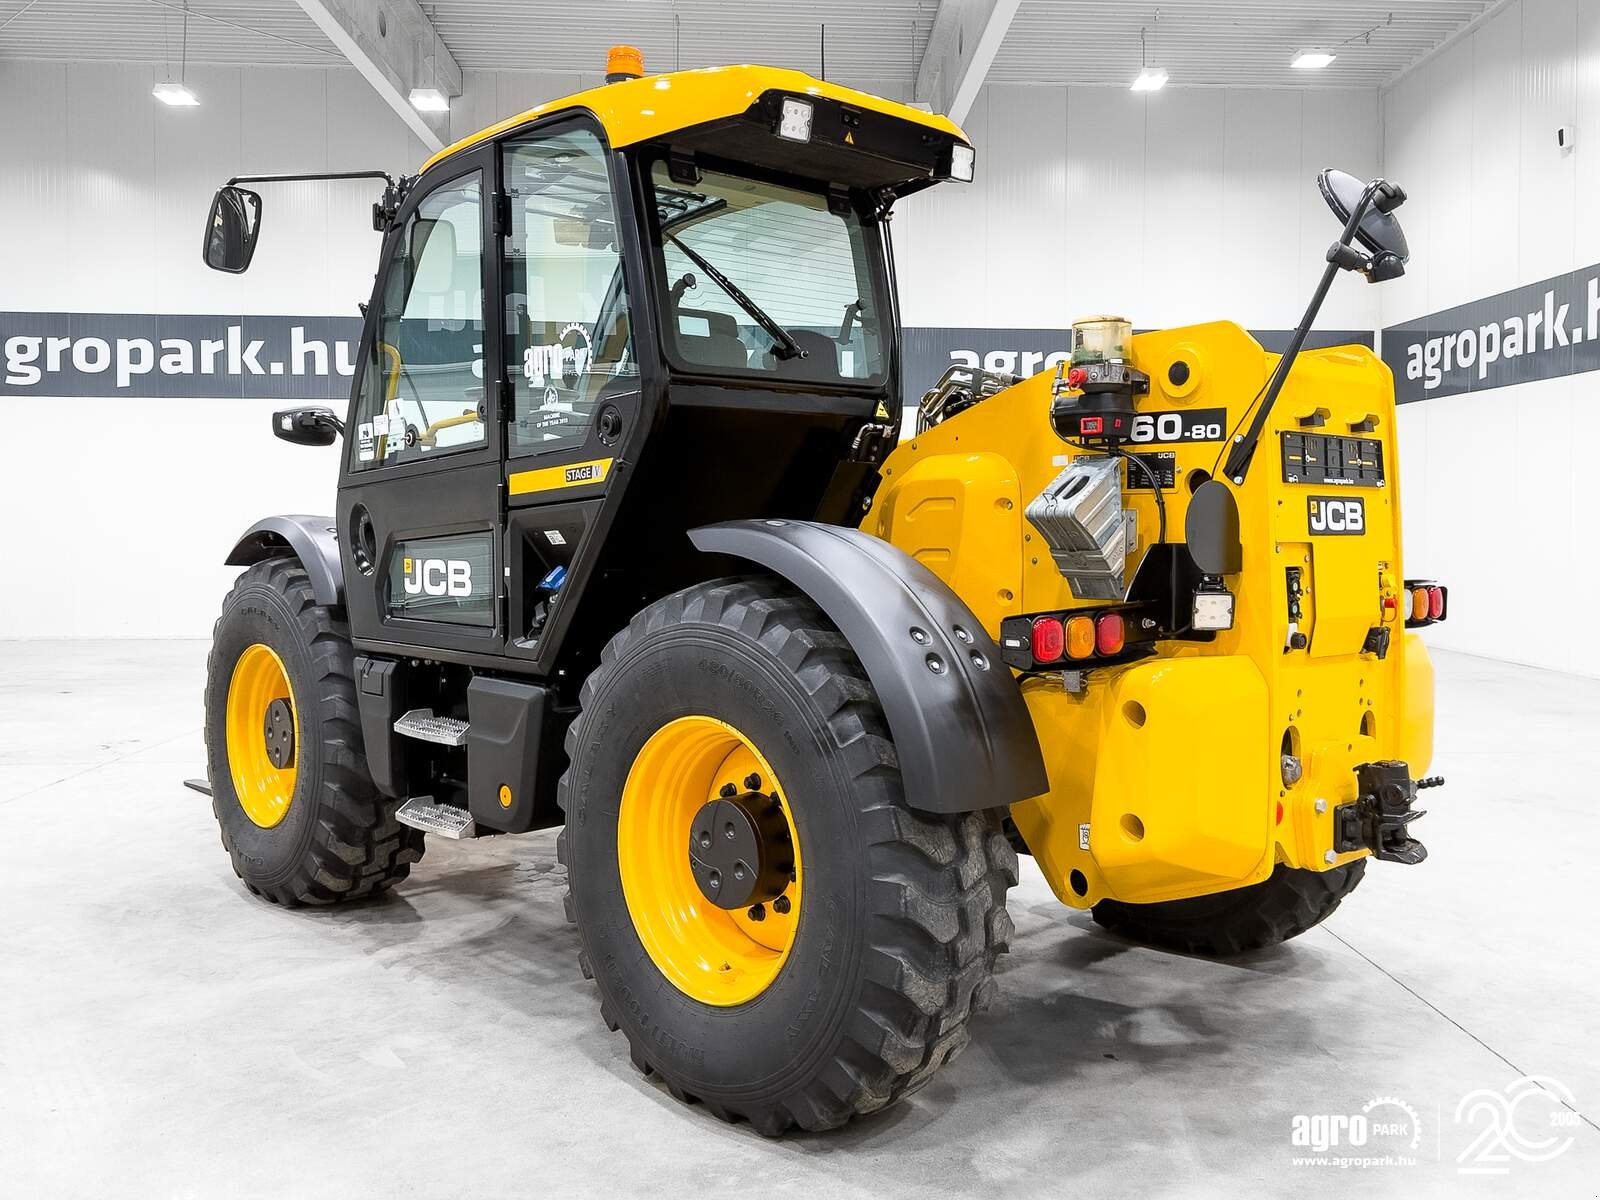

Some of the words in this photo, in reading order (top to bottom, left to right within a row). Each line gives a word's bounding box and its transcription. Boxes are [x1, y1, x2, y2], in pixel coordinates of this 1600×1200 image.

[566, 467, 591, 481] STAGE
[1310, 501, 1364, 531] JCB
[404, 559, 472, 597] JCB
